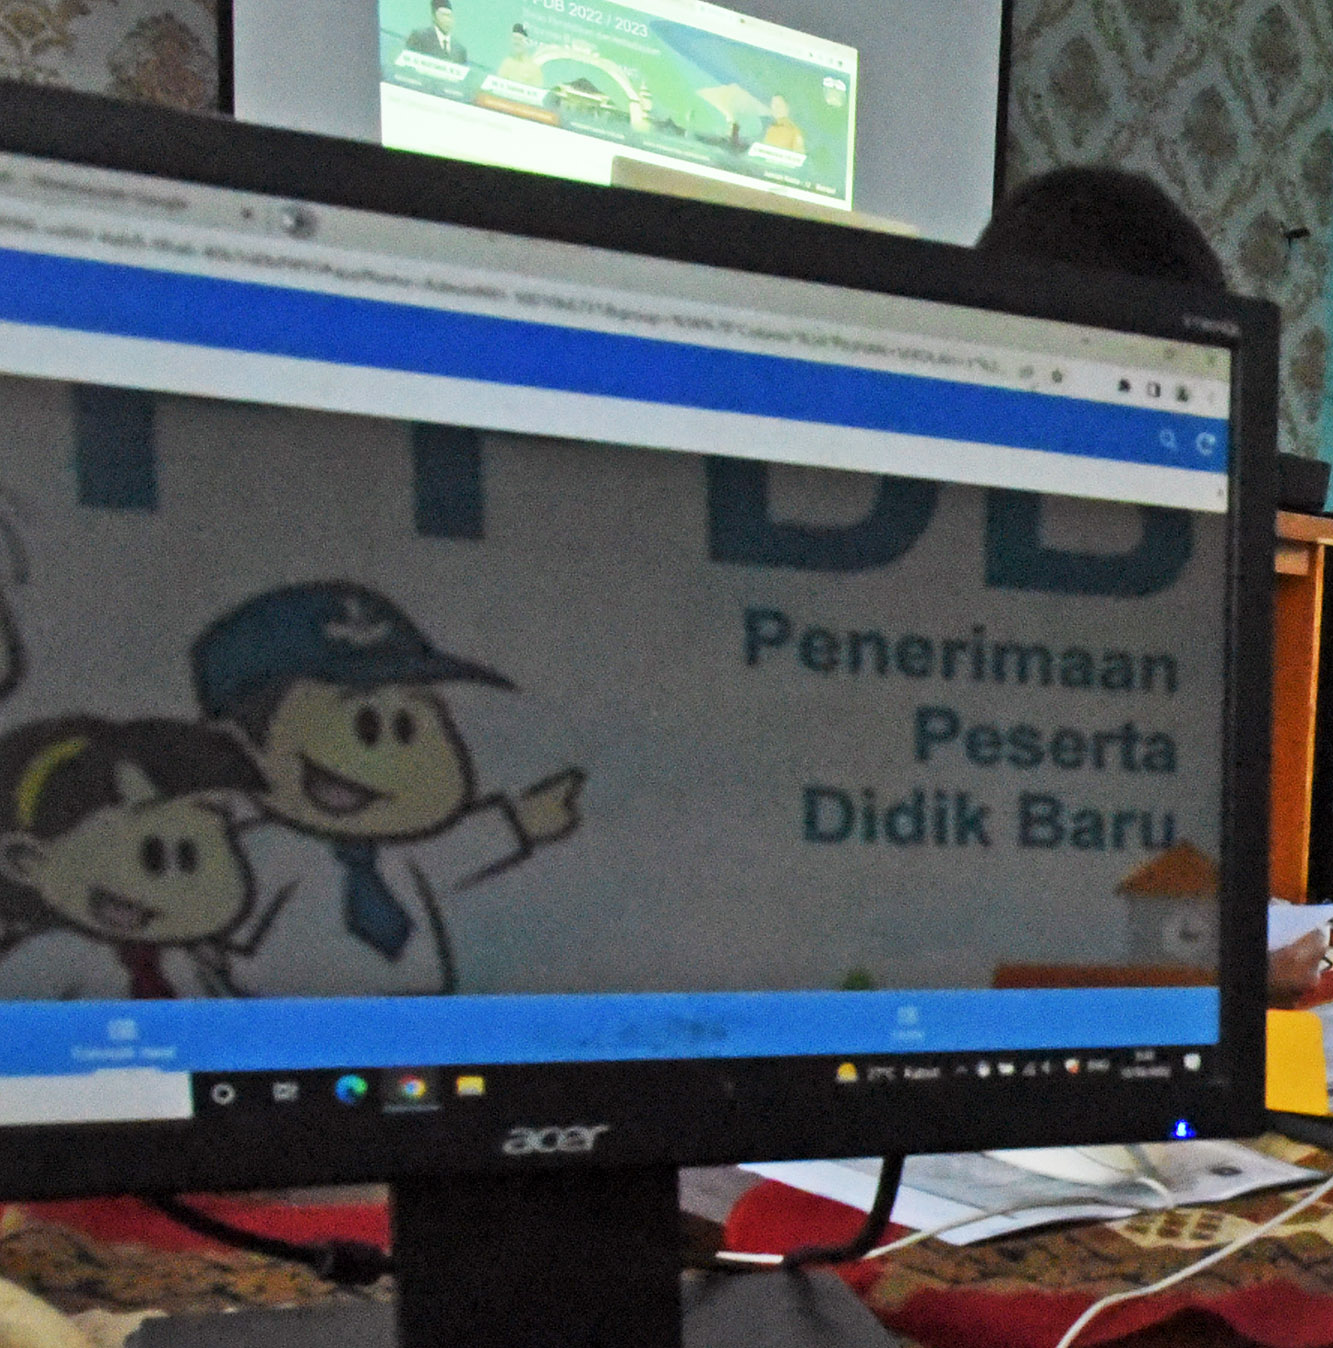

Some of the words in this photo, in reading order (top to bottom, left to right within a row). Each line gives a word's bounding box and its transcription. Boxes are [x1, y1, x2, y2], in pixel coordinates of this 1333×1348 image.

[569, 3, 602, 24] 2022
[615, 17, 649, 38] 2023
[743, 607, 1178, 692] Penerimaan
[913, 705, 1178, 774] Peserta
[803, 786, 992, 849] Didik
[1016, 791, 1178, 852] Baru
[502, 1124, 609, 1156] acer
